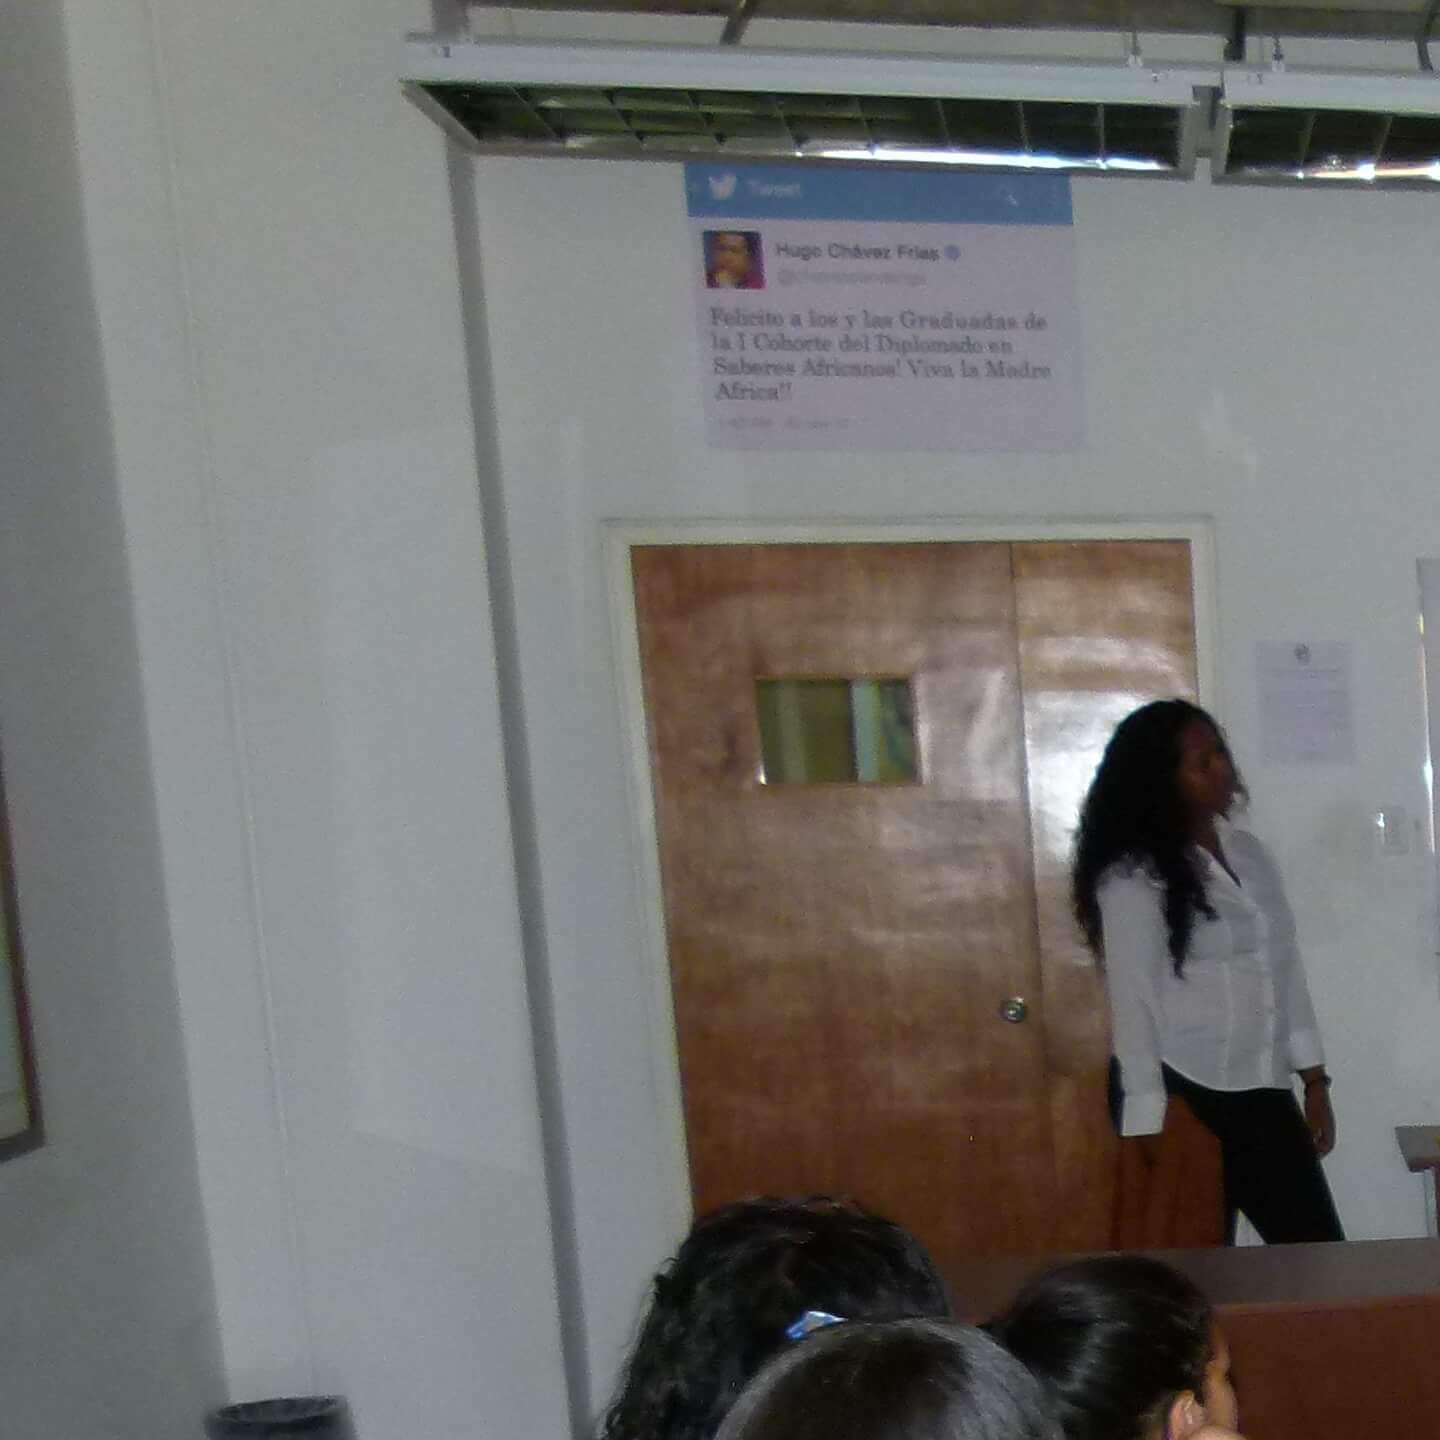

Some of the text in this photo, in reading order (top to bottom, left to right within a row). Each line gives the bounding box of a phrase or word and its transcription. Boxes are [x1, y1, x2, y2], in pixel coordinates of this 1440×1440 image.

[776, 242, 822, 261] Hugo
[827, 241, 891, 260] Chávez
[710, 306, 1048, 332] Felicito a los y las Graduadas de
[710, 331, 731, 350] la
[753, 332, 832, 351] Cohorte
[838, 333, 870, 352] del
[873, 333, 984, 357] Diplomado
[988, 340, 1014, 354] en
[713, 356, 796, 376] Saberes
[906, 358, 955, 378] Viva
[960, 359, 980, 378] la
[985, 359, 1052, 379] Madre
